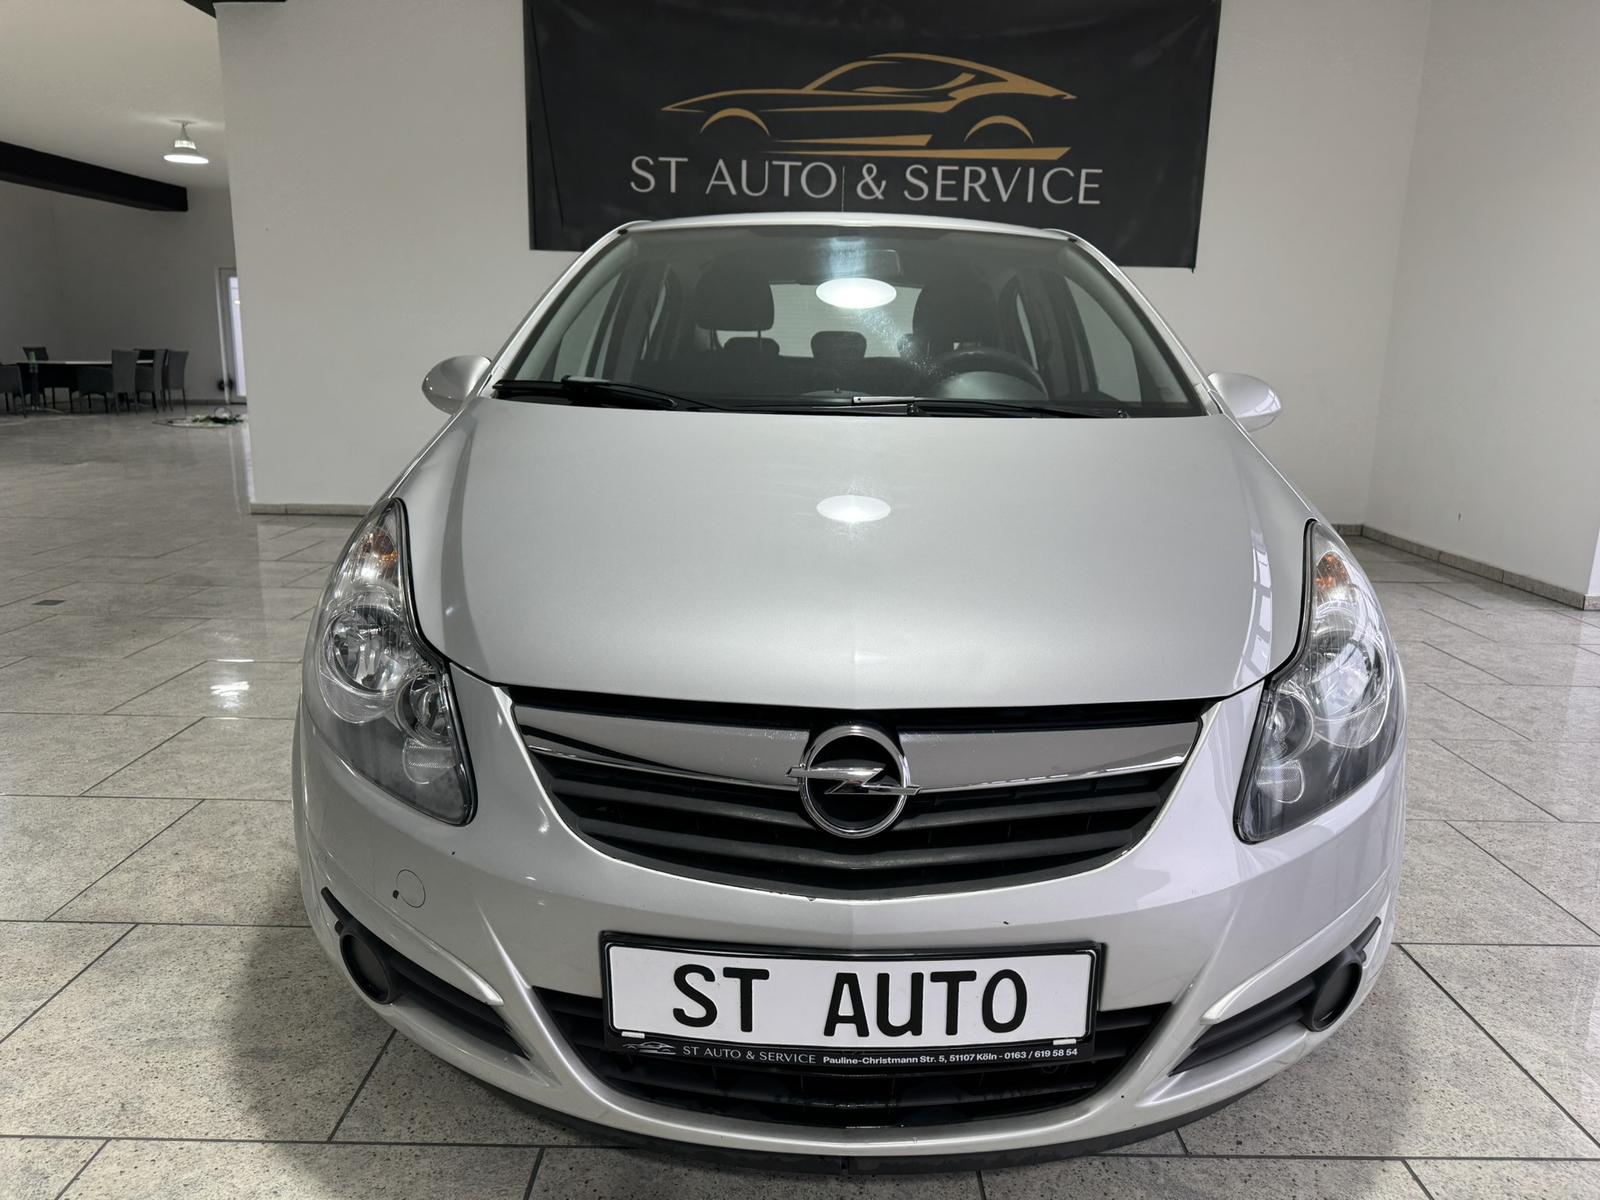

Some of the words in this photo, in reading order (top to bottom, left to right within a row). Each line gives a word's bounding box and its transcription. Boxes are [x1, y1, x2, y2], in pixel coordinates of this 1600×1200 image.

[630, 155, 689, 193] ST
[705, 158, 837, 199] AUTO
[856, 163, 887, 200] &
[904, 164, 1103, 205] SERVICE
[672, 963, 770, 1033] ST
[823, 968, 1028, 1038] AUTO
[683, 1045, 699, 1056] ST
[704, 1047, 742, 1059] AUTO
[745, 1050, 755, 1060] &
[759, 1052, 817, 1064] SERVICE
[823, 1056, 919, 1065] Pauline-Christmann
[920, 1055, 937, 1064] Str.
[938, 1055, 948, 1064] 5,
[949, 1054, 975, 1062] 51107
[976, 1052, 997, 1061] Köln
[1004, 1051, 1027, 1060] 0163
[1028, 1051, 1034, 1059] /
[1034, 1050, 1051, 1058] 619
[1052, 1049, 1065, 1057] 58
[1066, 1048, 1078, 1056] 54
